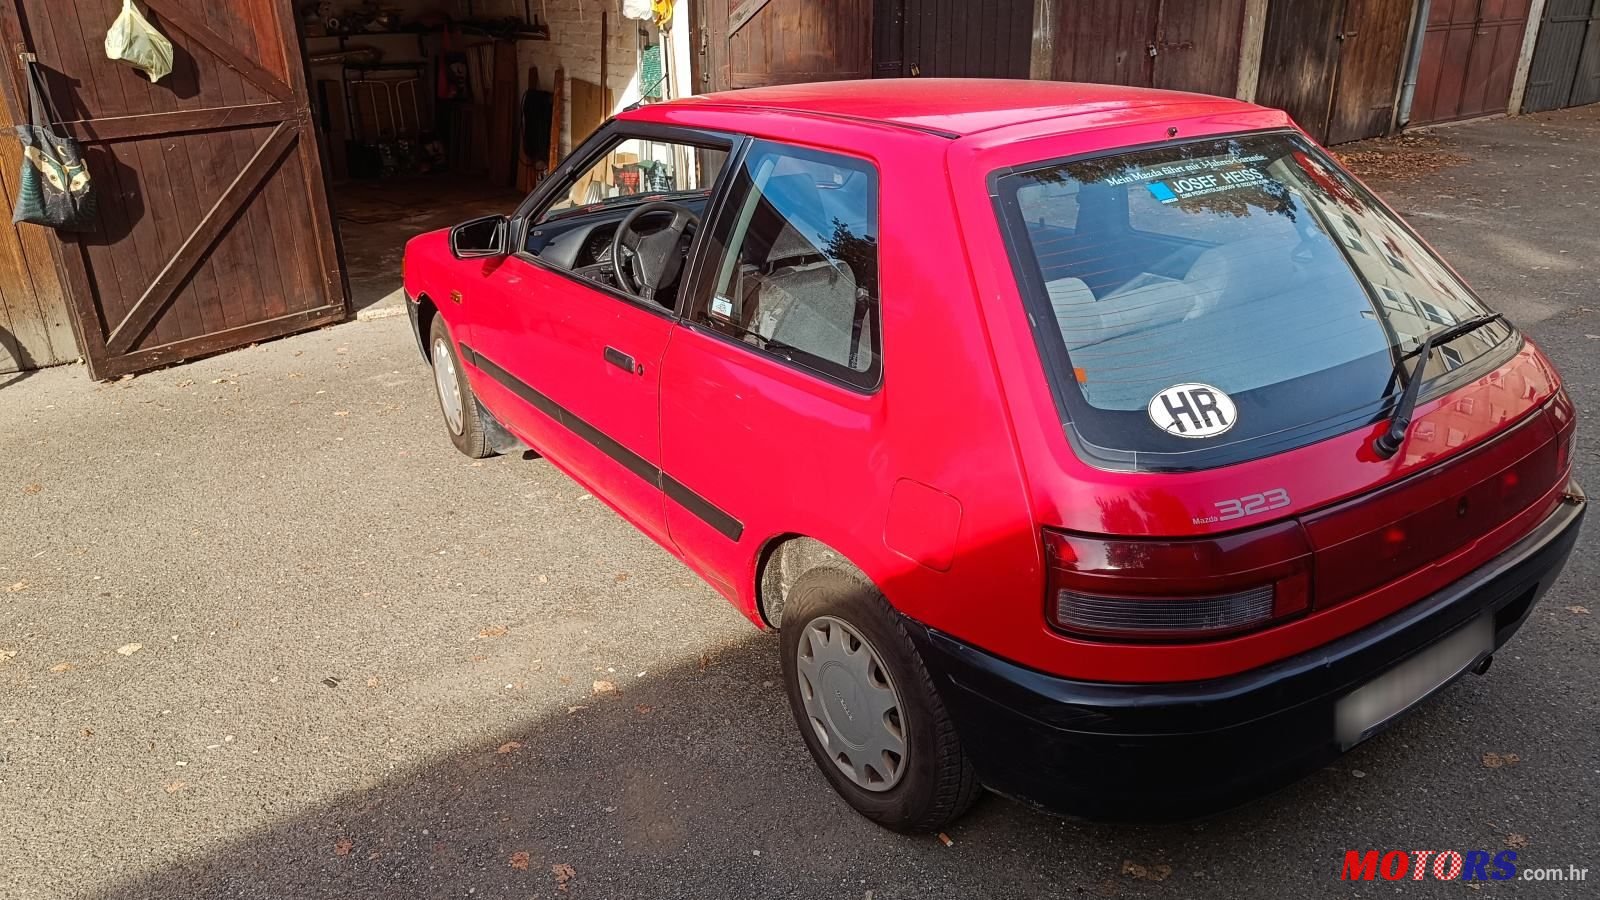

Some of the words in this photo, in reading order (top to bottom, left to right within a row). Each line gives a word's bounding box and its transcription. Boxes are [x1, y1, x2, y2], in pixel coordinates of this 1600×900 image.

[1105, 176, 1133, 187] Mein
[1130, 169, 1163, 181] Mazda
[1161, 165, 1185, 175] fährt
[1185, 162, 1201, 171] mit
[1172, 174, 1217, 193] JOSEF
[1220, 168, 1263, 184] HEISS
[1160, 388, 1228, 432] HR
[1192, 516, 1218, 525] Mazda
[1214, 488, 1290, 521] 323
